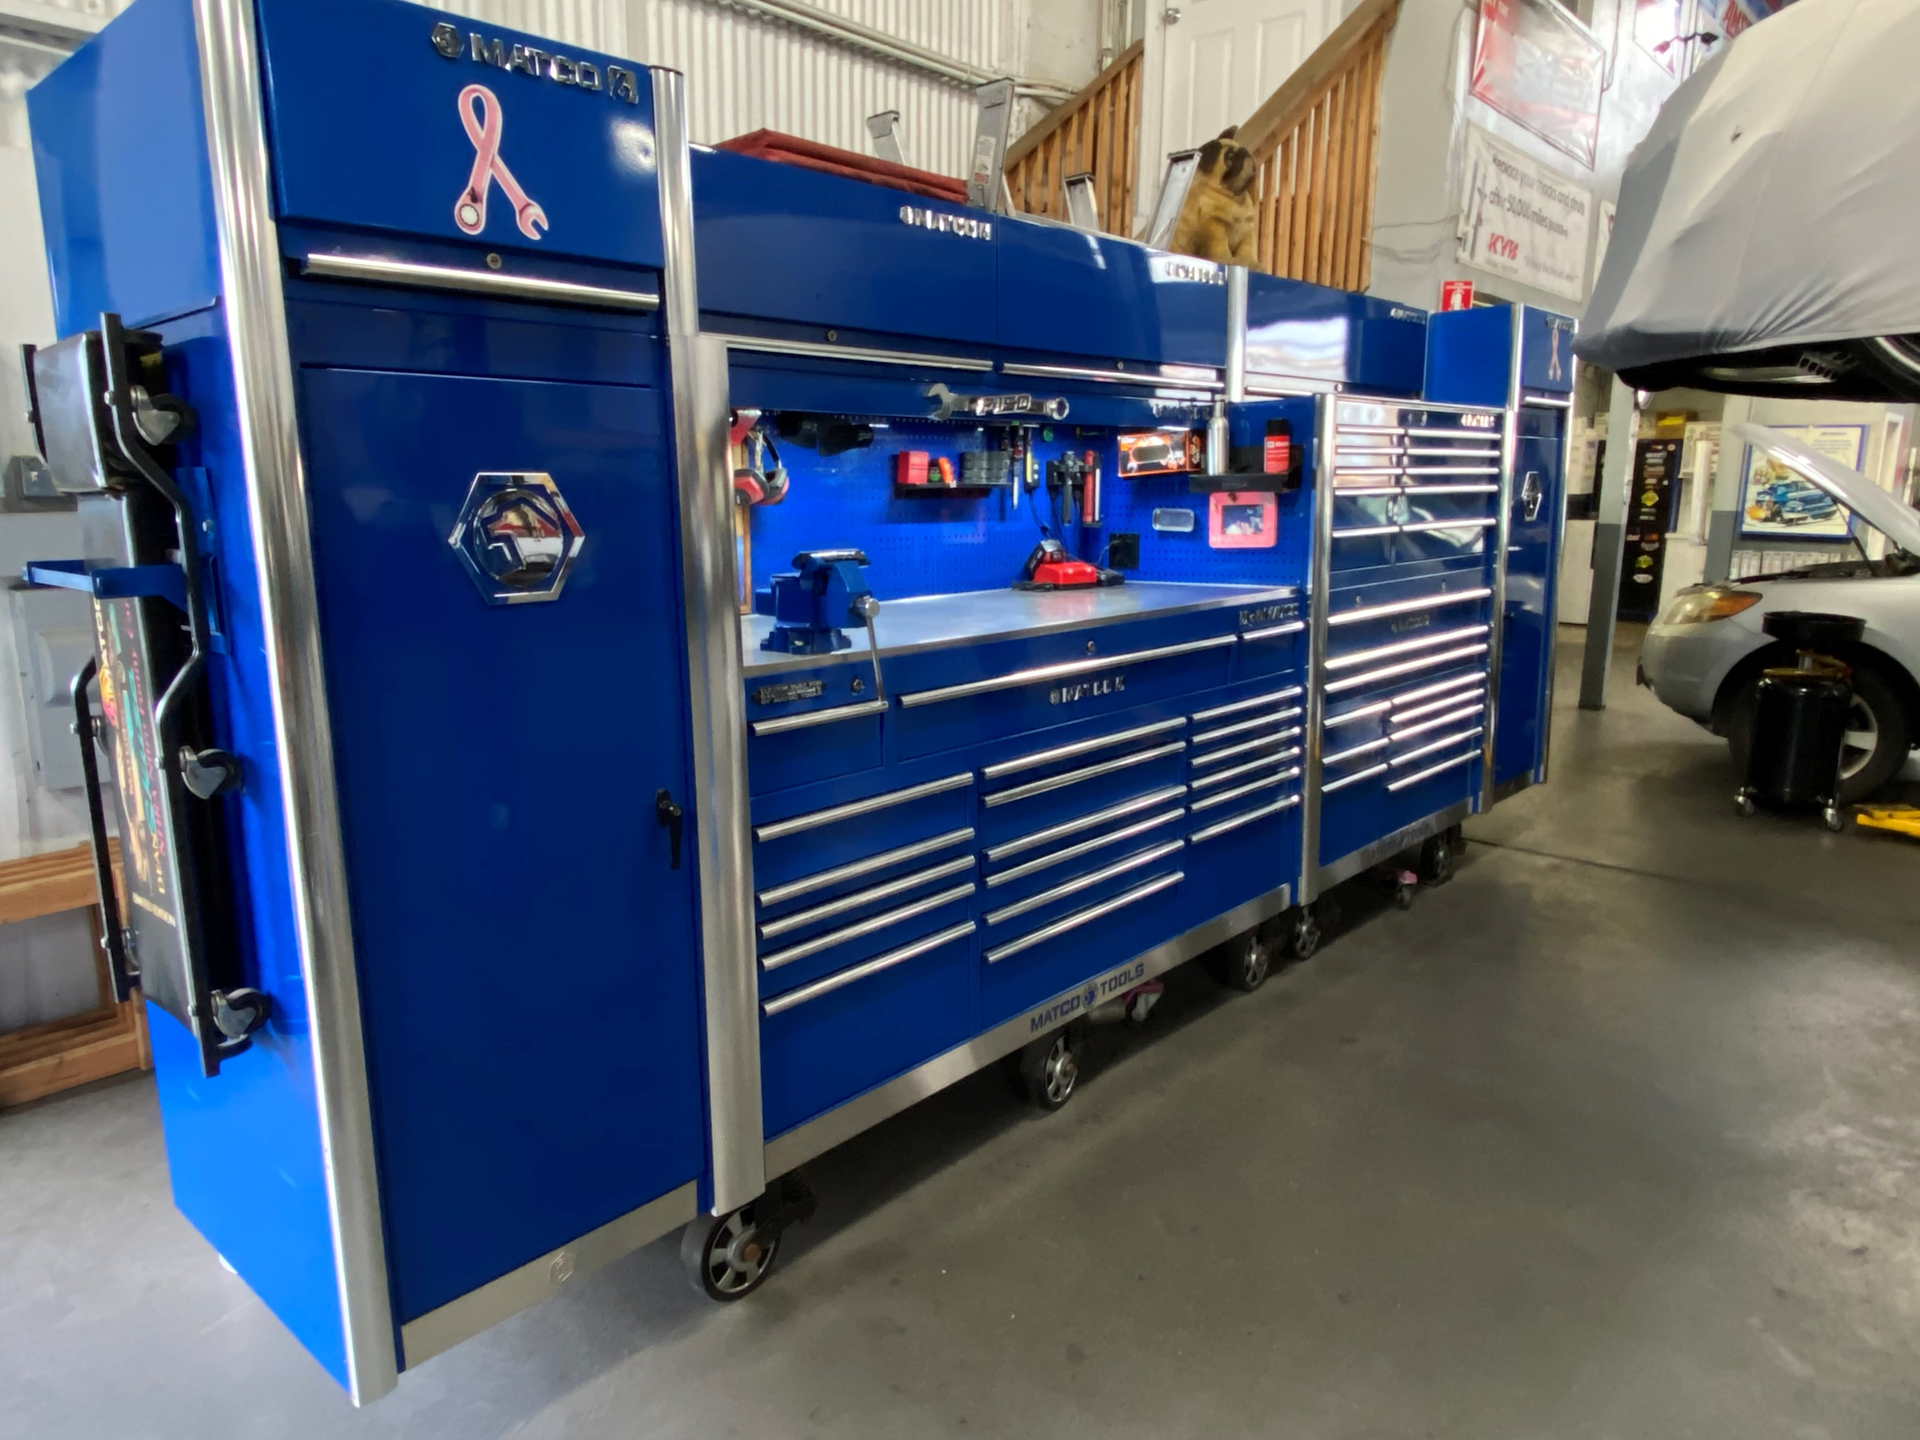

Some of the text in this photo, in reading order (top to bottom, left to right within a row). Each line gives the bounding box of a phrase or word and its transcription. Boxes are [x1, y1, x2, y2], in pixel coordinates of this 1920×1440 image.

[469, 32, 602, 90] MATCO
[914, 208, 978, 239] MATCO
[1487, 232, 1519, 260] KYB
[1030, 963, 1144, 1033] MATCO TOOLS
